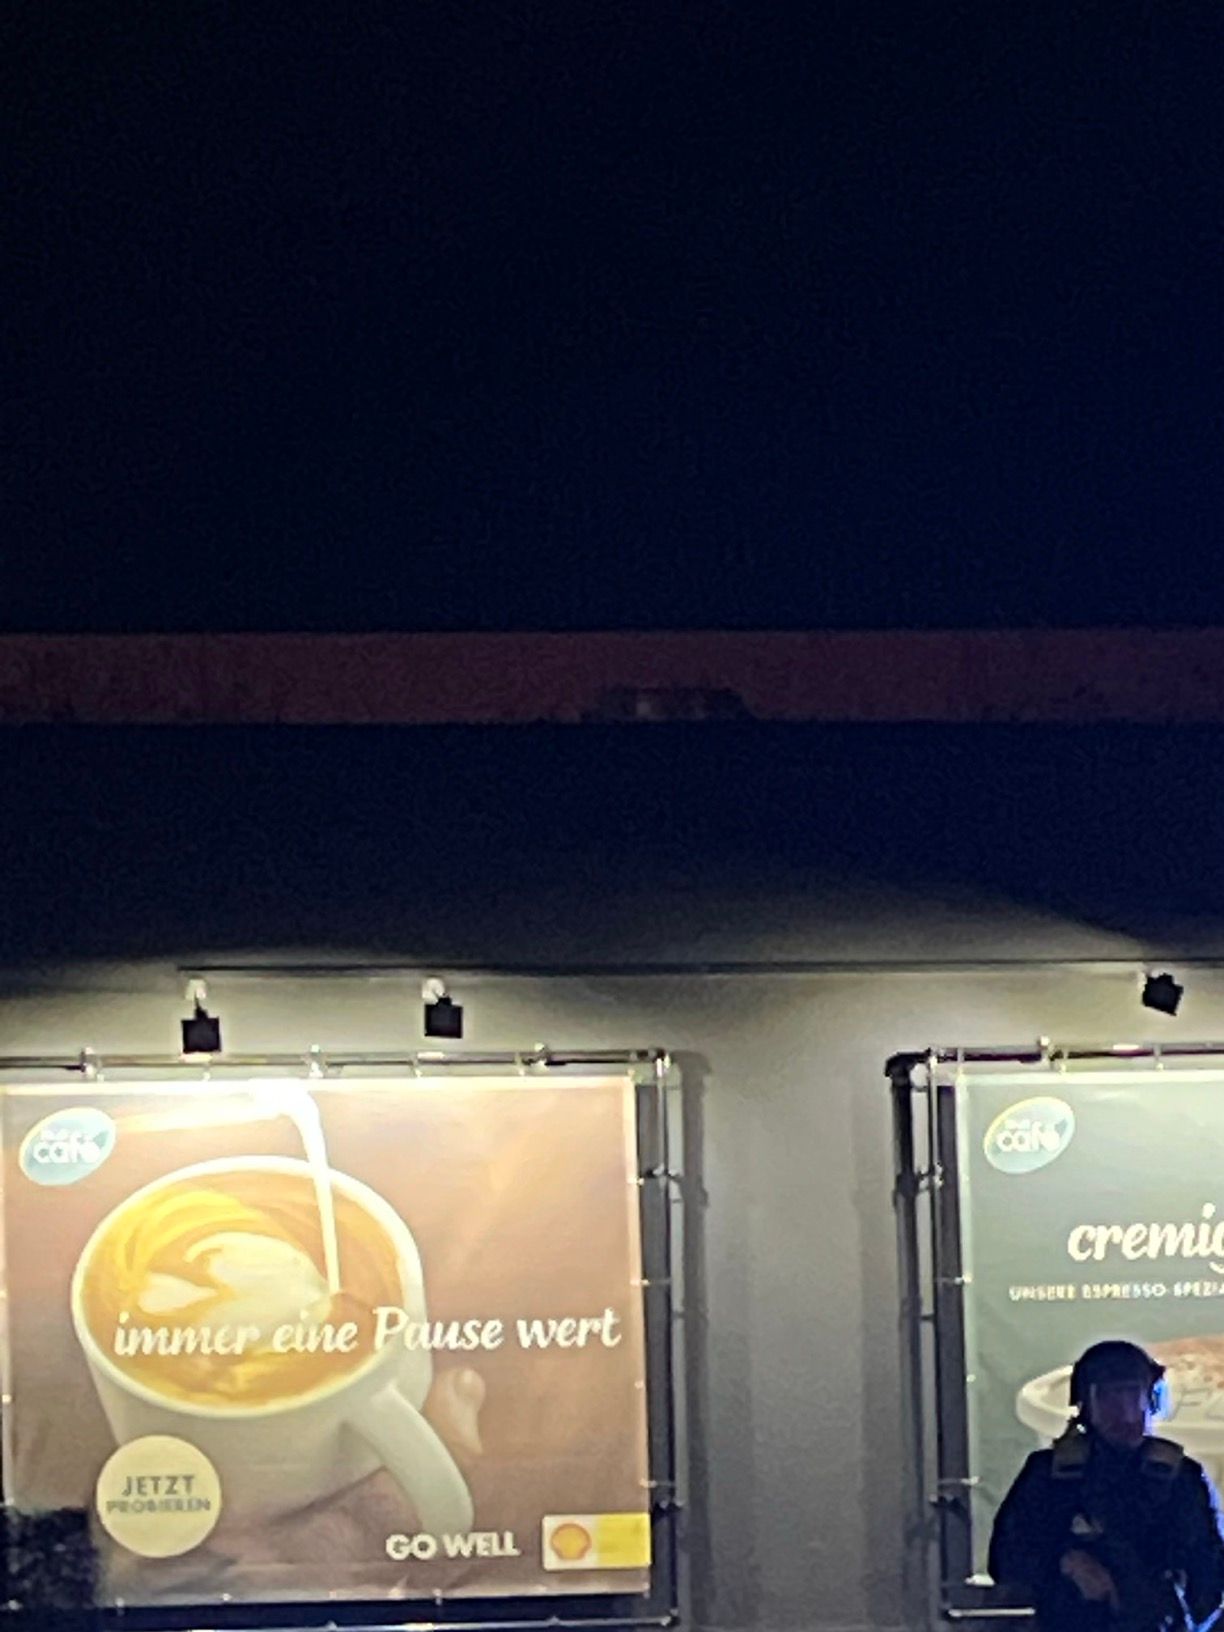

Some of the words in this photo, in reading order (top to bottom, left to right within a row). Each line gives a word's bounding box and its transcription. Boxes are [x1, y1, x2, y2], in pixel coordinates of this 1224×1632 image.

[1008, 1284, 1076, 1301] UNSERE
[113, 1310, 262, 1356] immer
[272, 1309, 359, 1353] eine
[372, 1306, 504, 1351] Pause
[516, 1307, 622, 1349] wert
[121, 1475, 195, 1497] JETZT
[106, 1498, 212, 1514] PROBIEREN
[385, 1533, 437, 1560] GO
[442, 1530, 521, 1559] WELL
